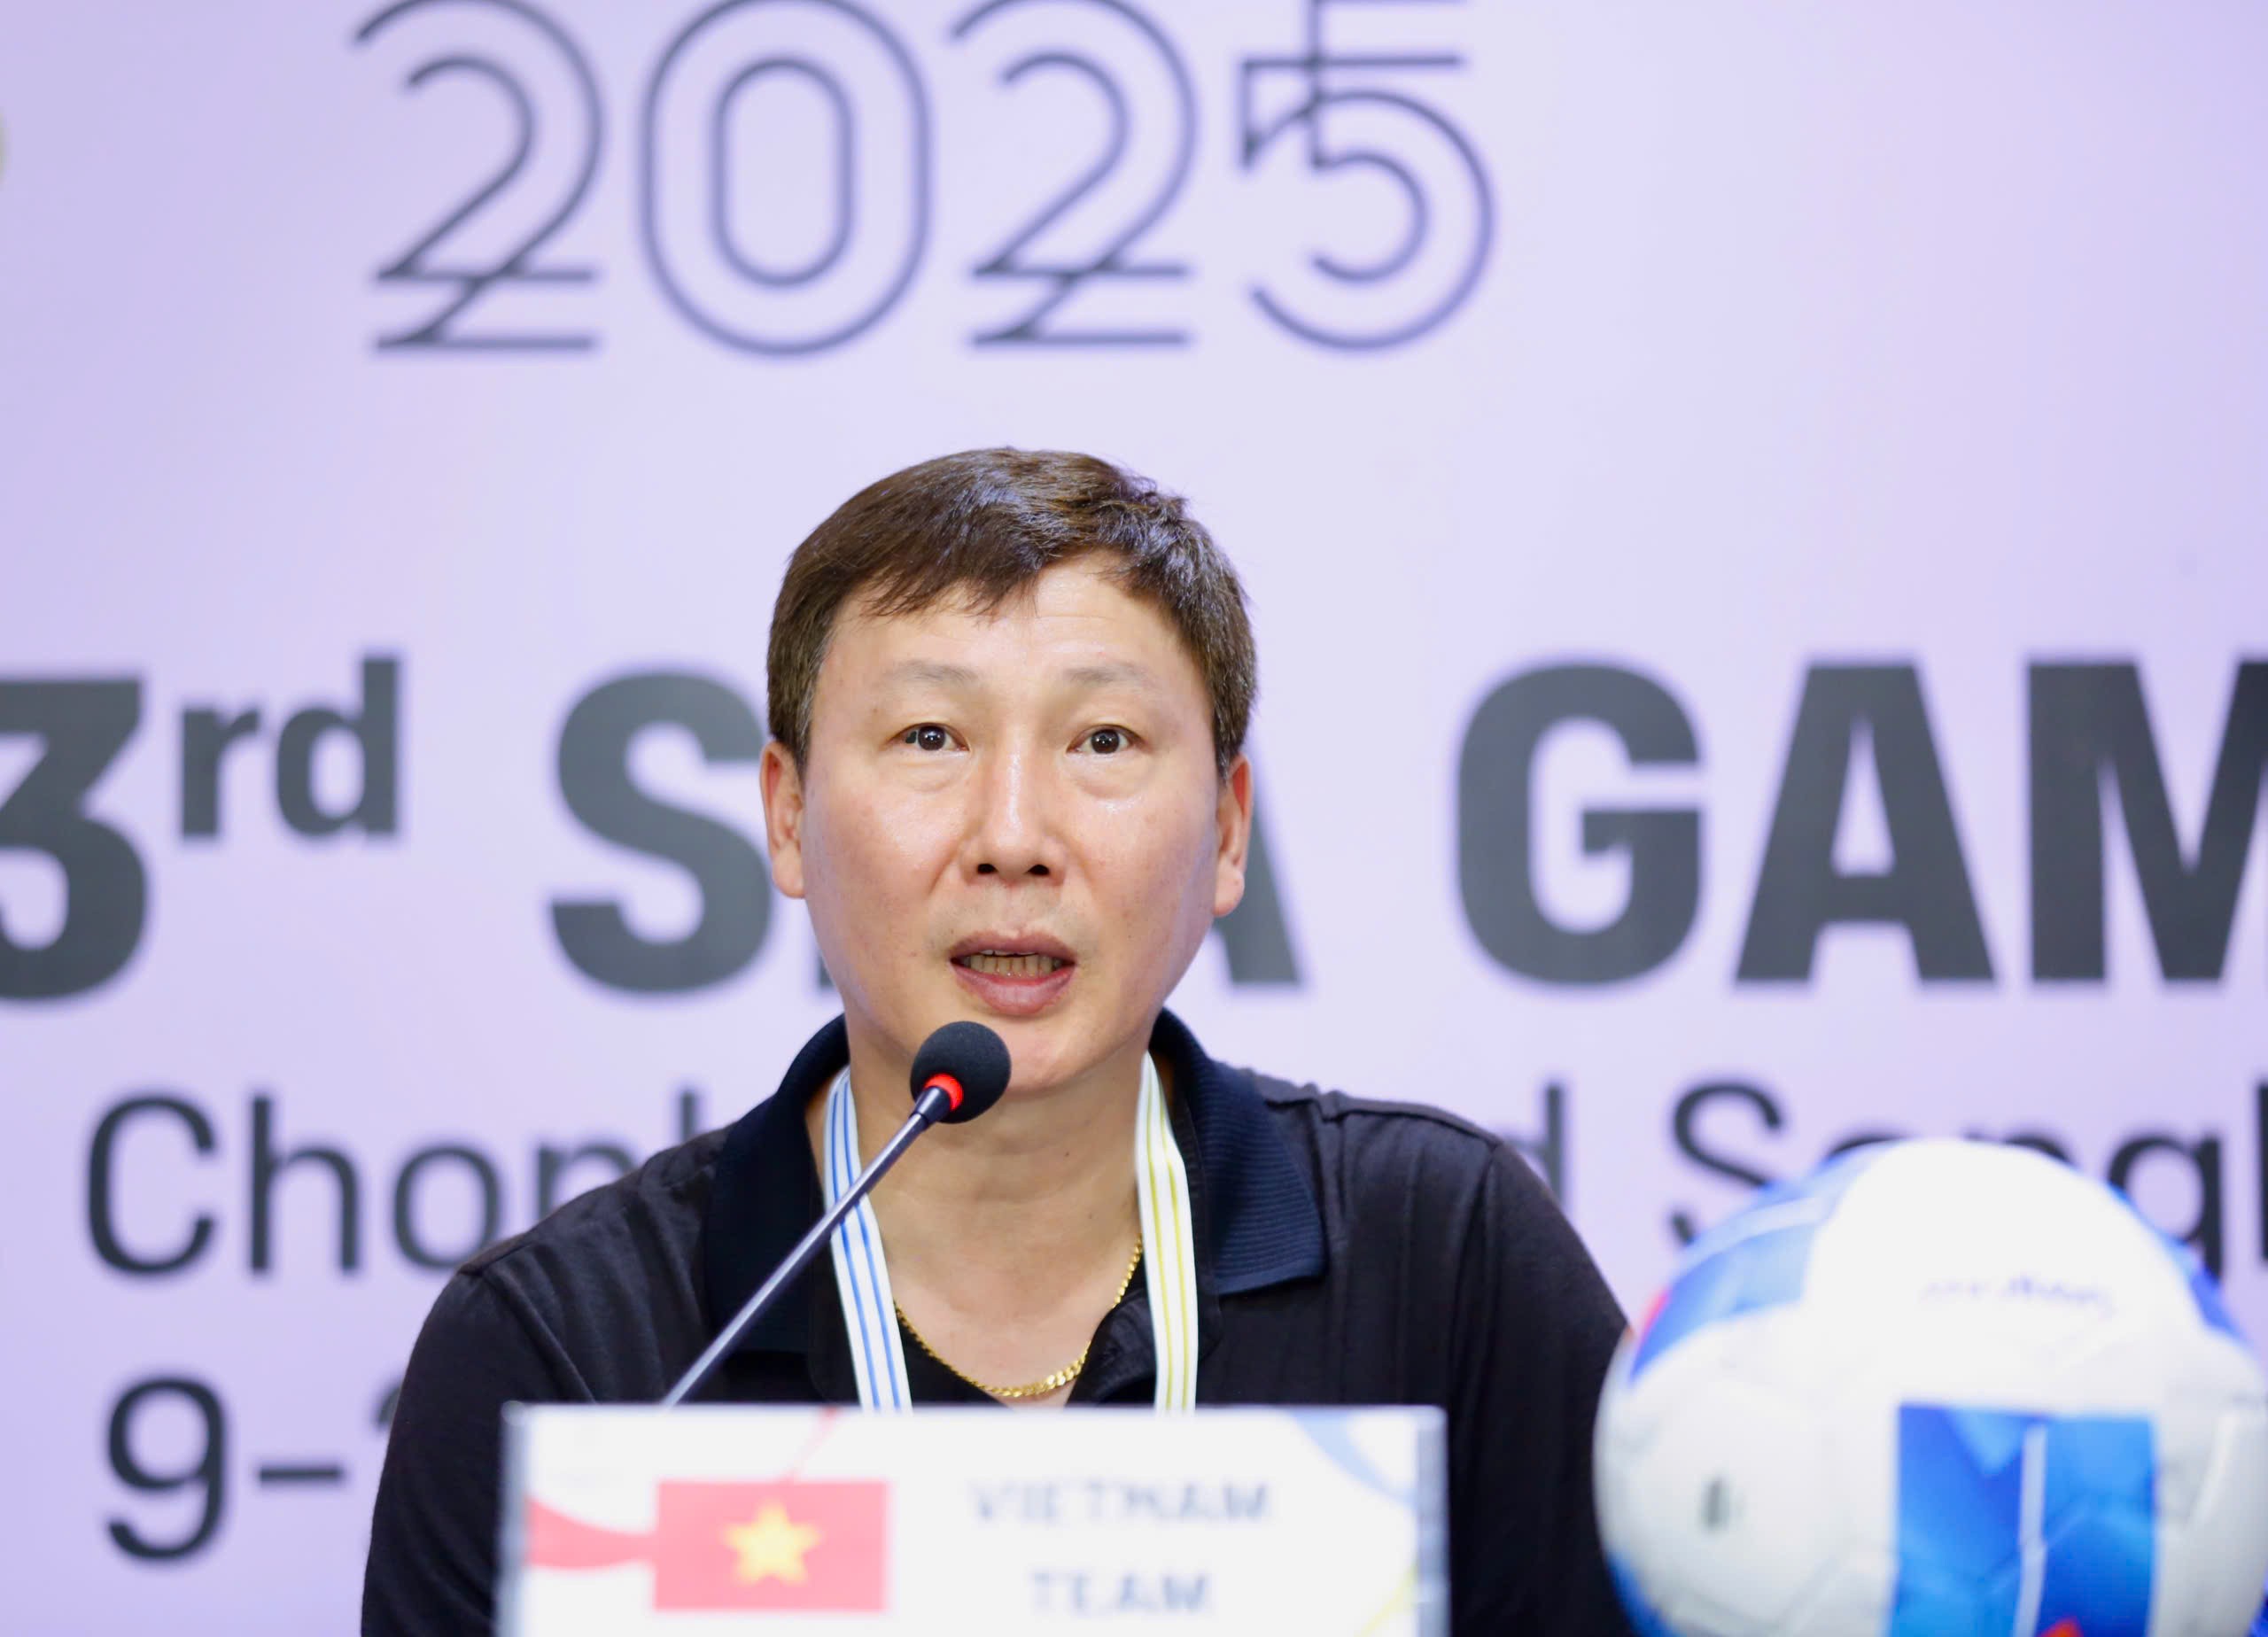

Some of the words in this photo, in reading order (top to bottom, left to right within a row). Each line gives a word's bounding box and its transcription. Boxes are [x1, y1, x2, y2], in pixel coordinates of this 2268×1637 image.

[351, 0, 1499, 356] 2025
[1454, 656, 2268, 990] GAM
[85, 1086, 707, 1279] Chon
[103, 1371, 400, 1566] 9-
[1029, 1569, 1216, 1618] TEAM
